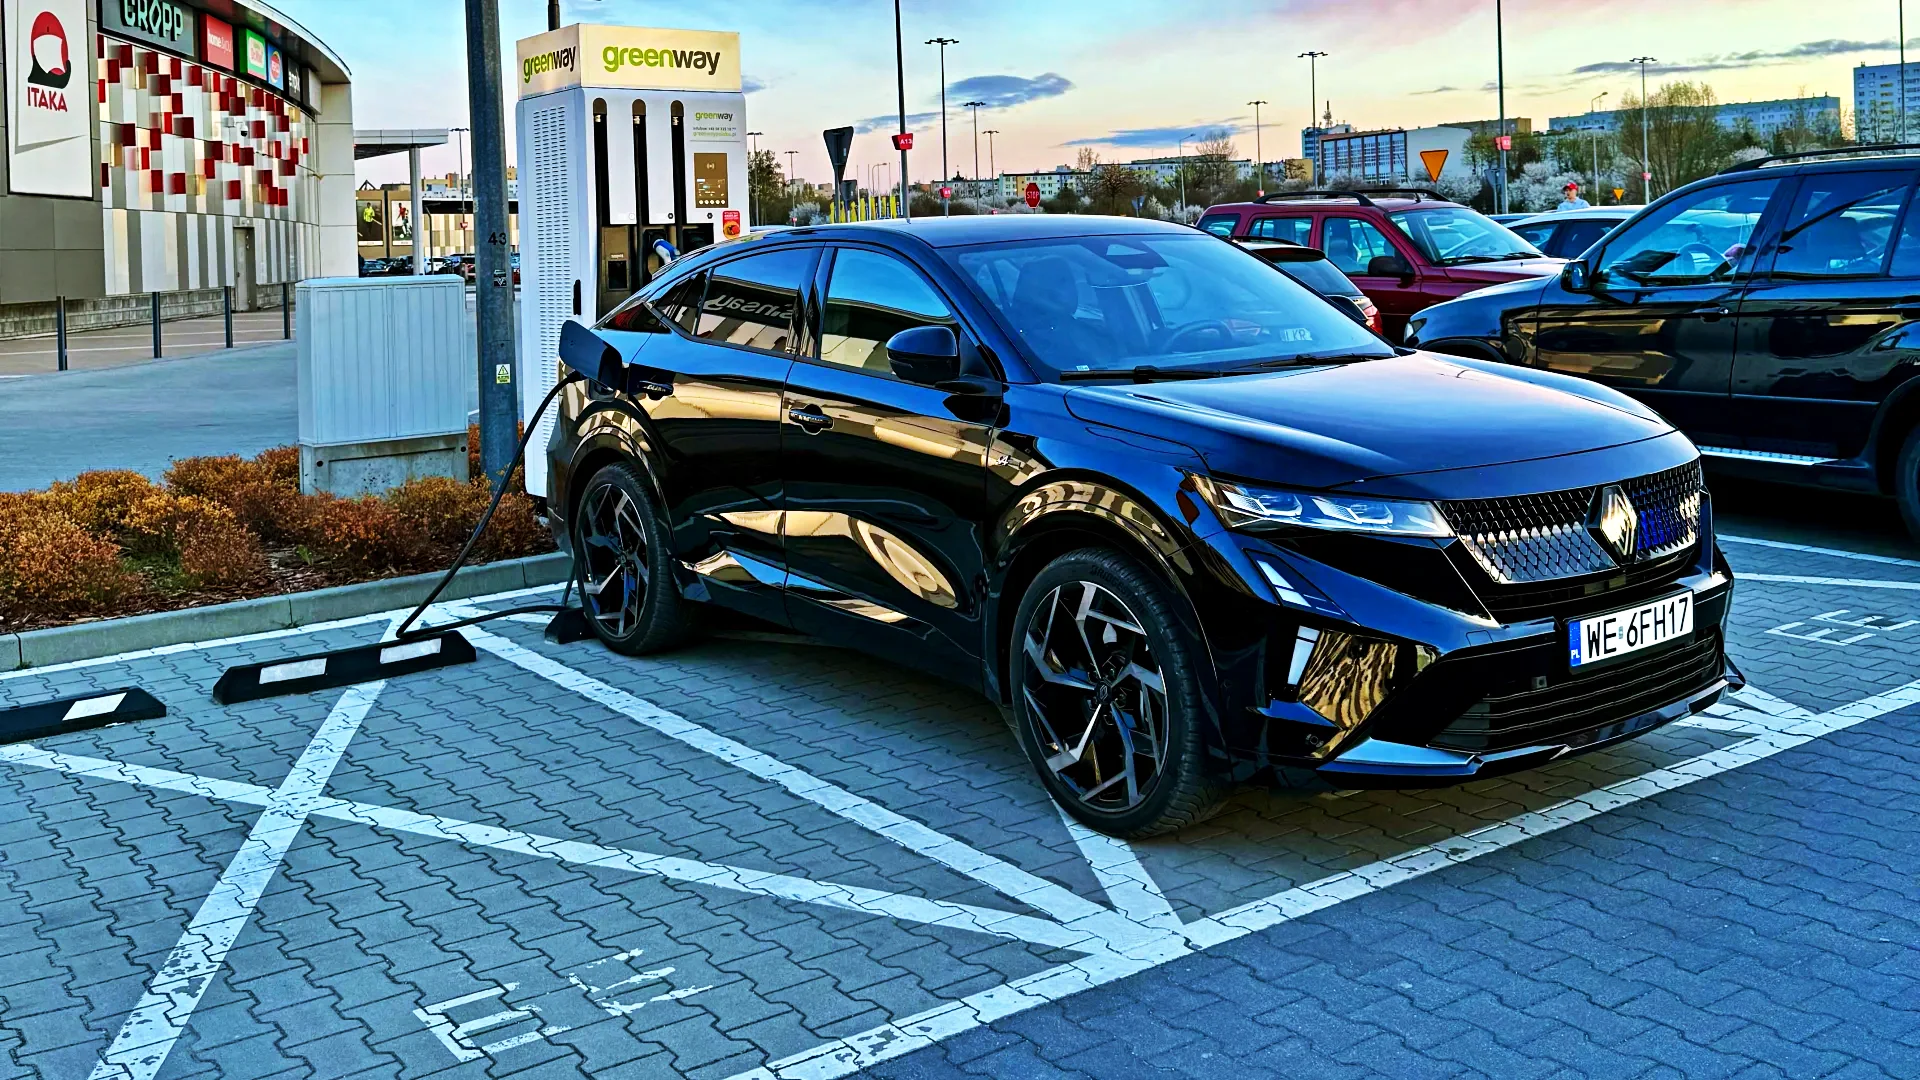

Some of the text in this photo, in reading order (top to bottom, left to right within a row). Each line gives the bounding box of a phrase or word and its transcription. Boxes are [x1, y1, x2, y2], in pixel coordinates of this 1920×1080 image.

[123, 0, 183, 41] CROPP
[523, 45, 576, 84] greenway
[603, 46, 721, 76] greenway
[27, 86, 68, 112] ITAKA
[695, 112, 733, 121] greenway
[1026, 190, 1040, 199] STOP
[487, 231, 507, 246] 43
[1586, 596, 1689, 659] WE 6FH17
[1570, 649, 1581, 660] PL
